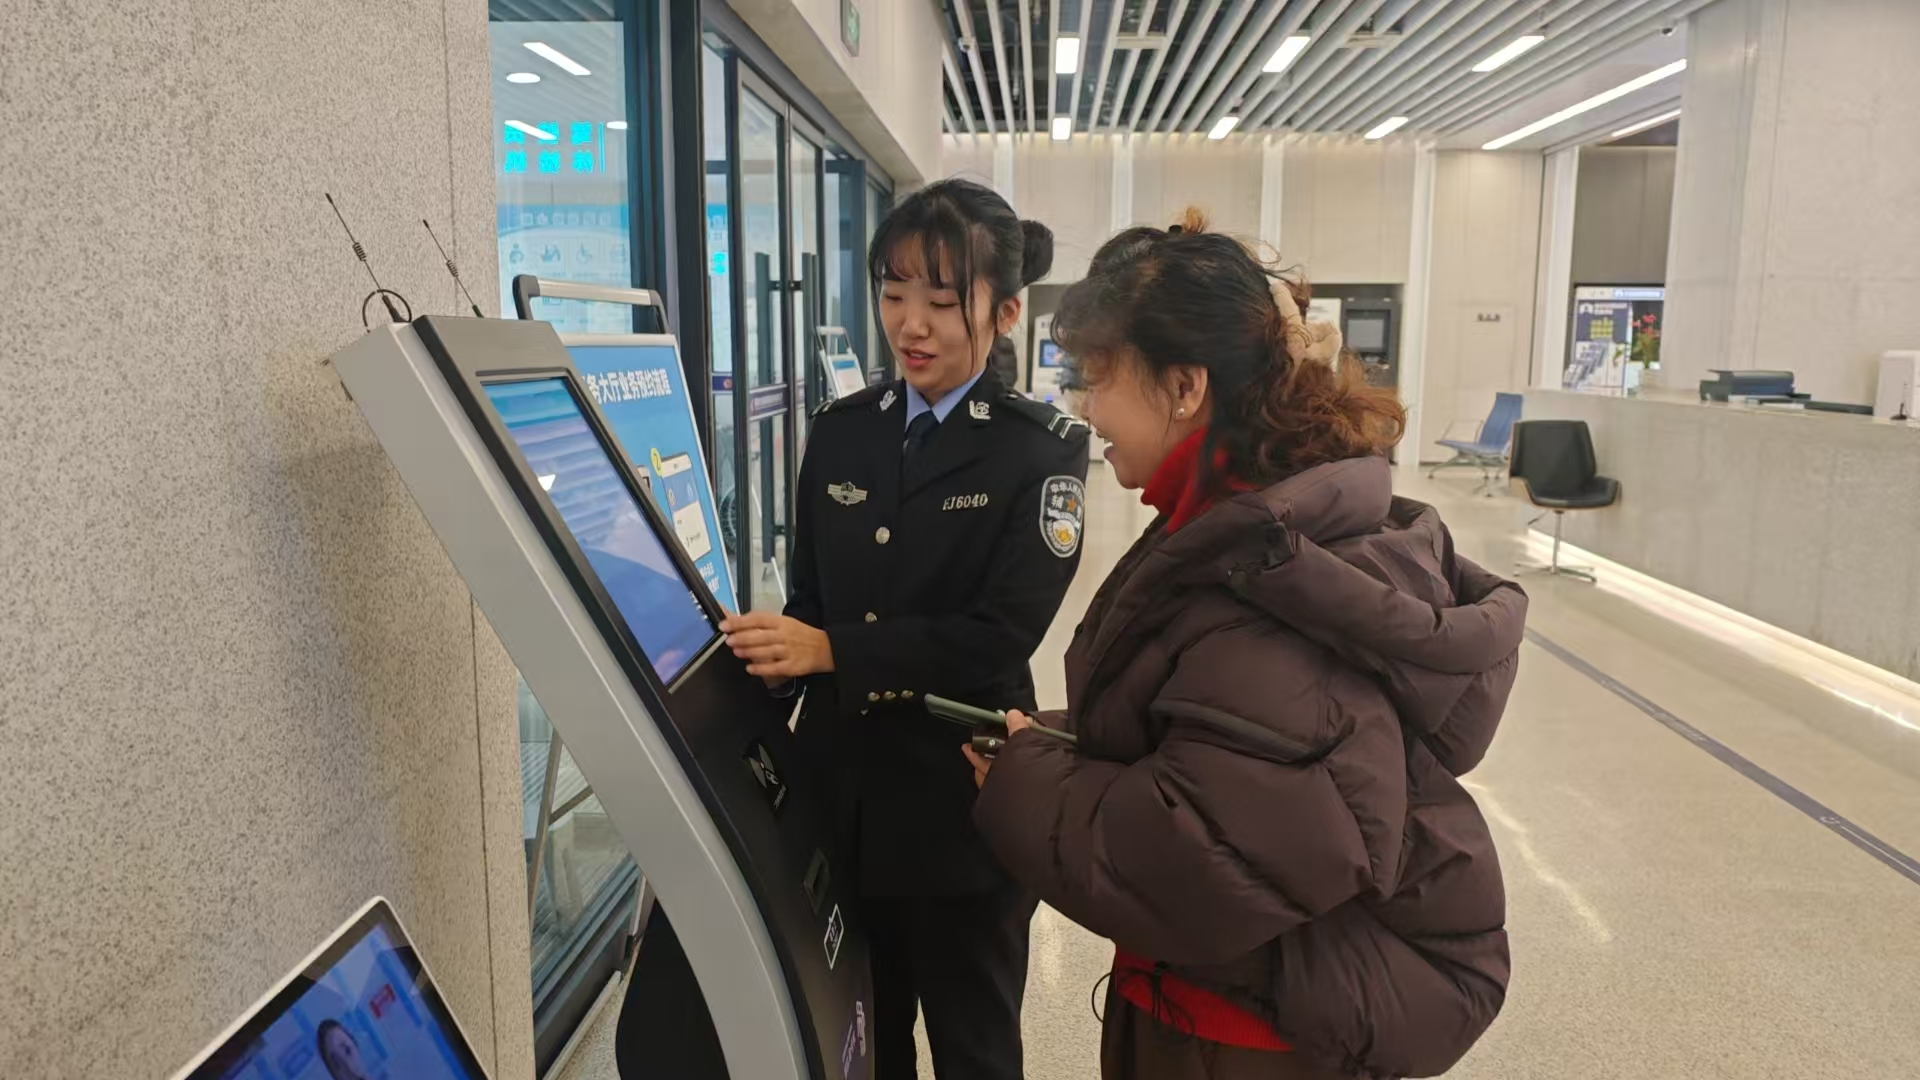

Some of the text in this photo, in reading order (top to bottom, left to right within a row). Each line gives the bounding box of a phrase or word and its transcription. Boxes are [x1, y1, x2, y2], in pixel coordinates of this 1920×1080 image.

[583, 368, 671, 404] 务大厅业务预约流程
[942, 493, 988, 511] FJ6040
